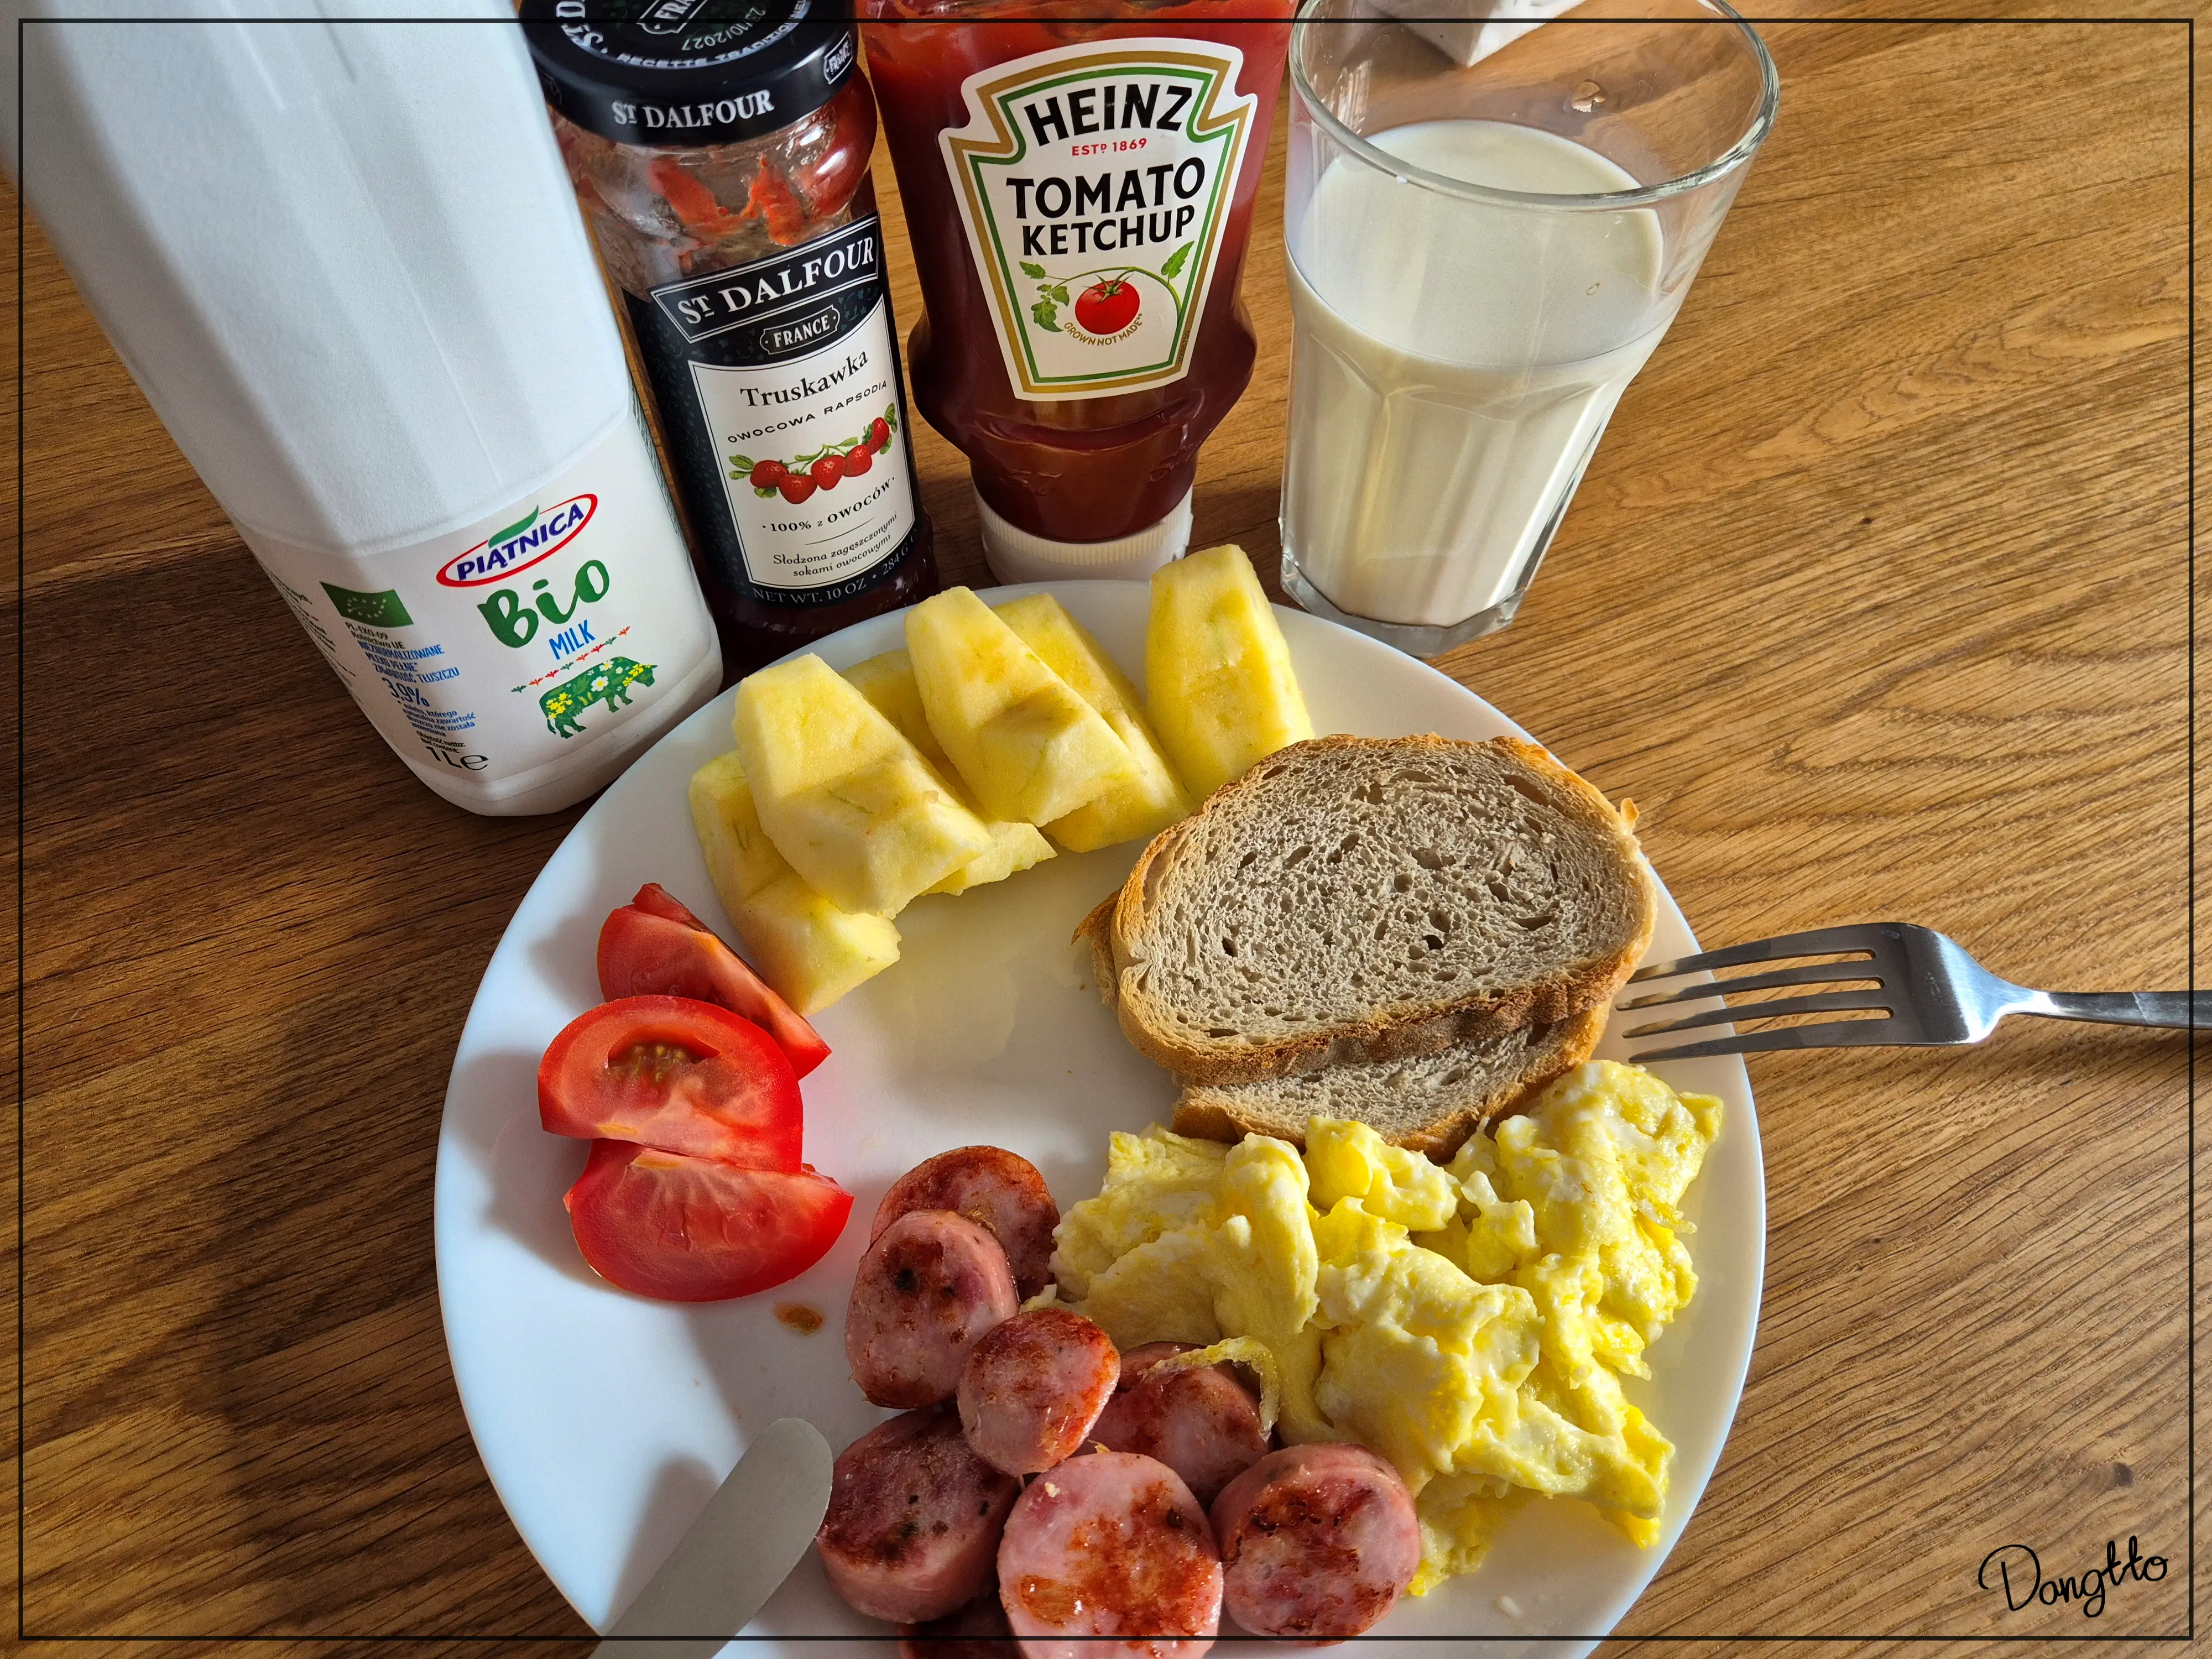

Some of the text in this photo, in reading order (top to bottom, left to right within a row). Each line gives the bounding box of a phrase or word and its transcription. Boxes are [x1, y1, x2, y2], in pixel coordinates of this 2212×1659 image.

[612, 89, 775, 128] ST DALFOUR
[1023, 84, 1192, 147] HEINZ
[1112, 138, 1147, 152] 1869
[1006, 157, 1205, 219] TOMATO
[1022, 204, 1195, 256] KETCHUP
[677, 236, 874, 325] ST DALFOUR
[772, 314, 830, 348] FRANCE
[1064, 322, 1096, 346] GROWN
[1097, 336, 1117, 346] NOT
[740, 351, 868, 406] Truskawka
[728, 380, 887, 443] OWOCOWA RAPSODIA
[457, 503, 584, 581] PIĄTNICA
[773, 554, 827, 565] Słodzona
[831, 512, 897, 557] zagęszczonymi
[793, 565, 833, 577] sokami
[836, 531, 891, 568] owocowymi
[753, 588, 785, 603] NET
[790, 593, 823, 604] WT.
[826, 588, 841, 600] 10
[845, 578, 867, 594] OZ
[882, 555, 901, 576] 284
[477, 560, 609, 648] Bio
[345, 622, 388, 640] PL-EKO-09
[549, 619, 596, 660] MILK
[416, 667, 460, 683] TŁUSZCZU
[426, 710, 457, 718] którego
[436, 712, 476, 724] zawartość
[447, 721, 475, 731] została
